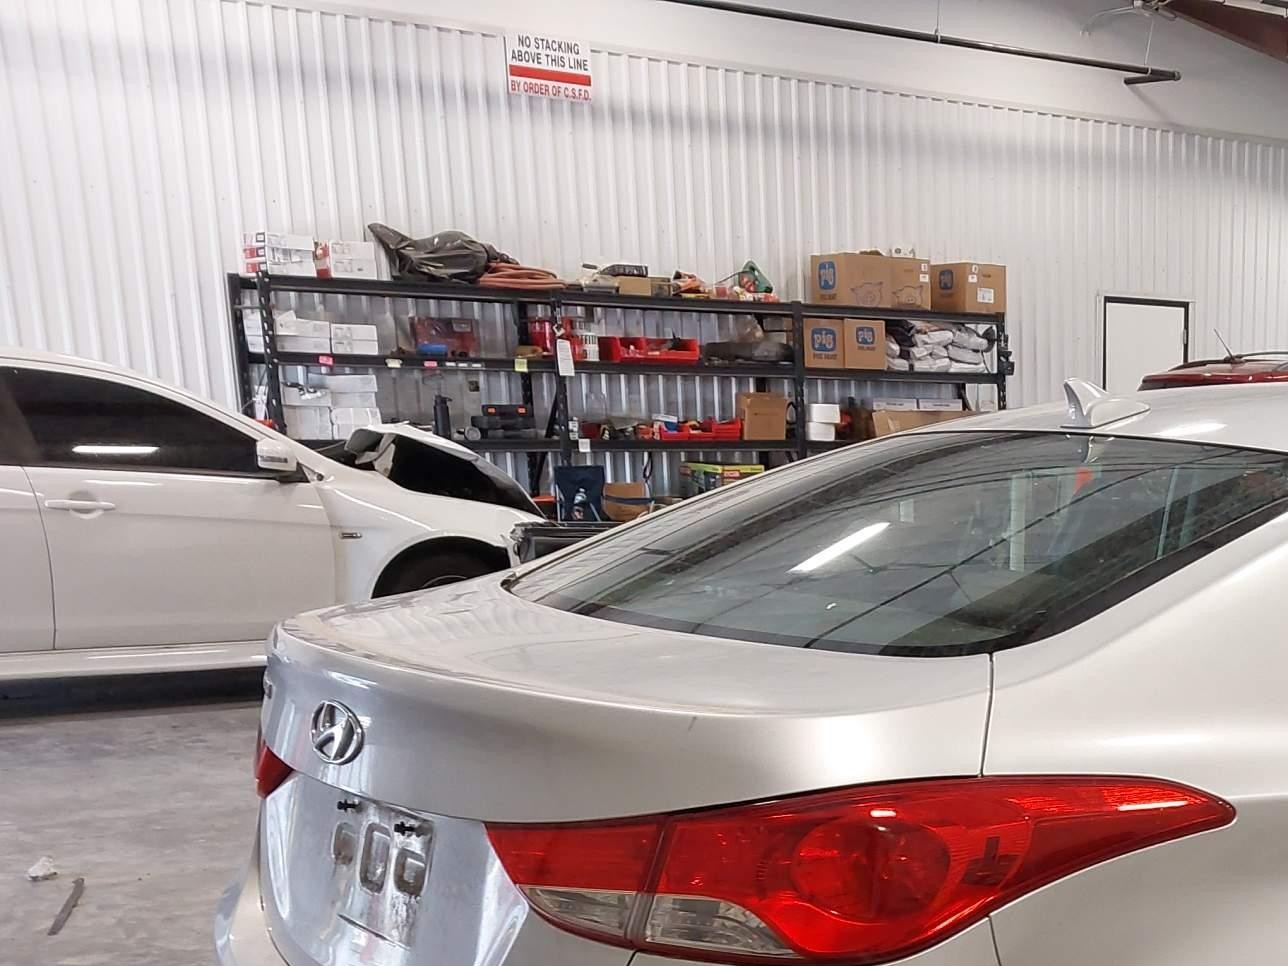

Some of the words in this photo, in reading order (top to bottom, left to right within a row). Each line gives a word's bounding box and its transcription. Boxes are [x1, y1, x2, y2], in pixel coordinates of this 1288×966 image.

[518, 34, 531, 48] NO
[534, 37, 580, 55] STACKING
[511, 49, 542, 64] ABOVE
[545, 54, 566, 68] THIS
[568, 57, 588, 71] LINE
[511, 80, 520, 91] BY
[523, 81, 550, 96] ORDER
[552, 85, 561, 97] OF
